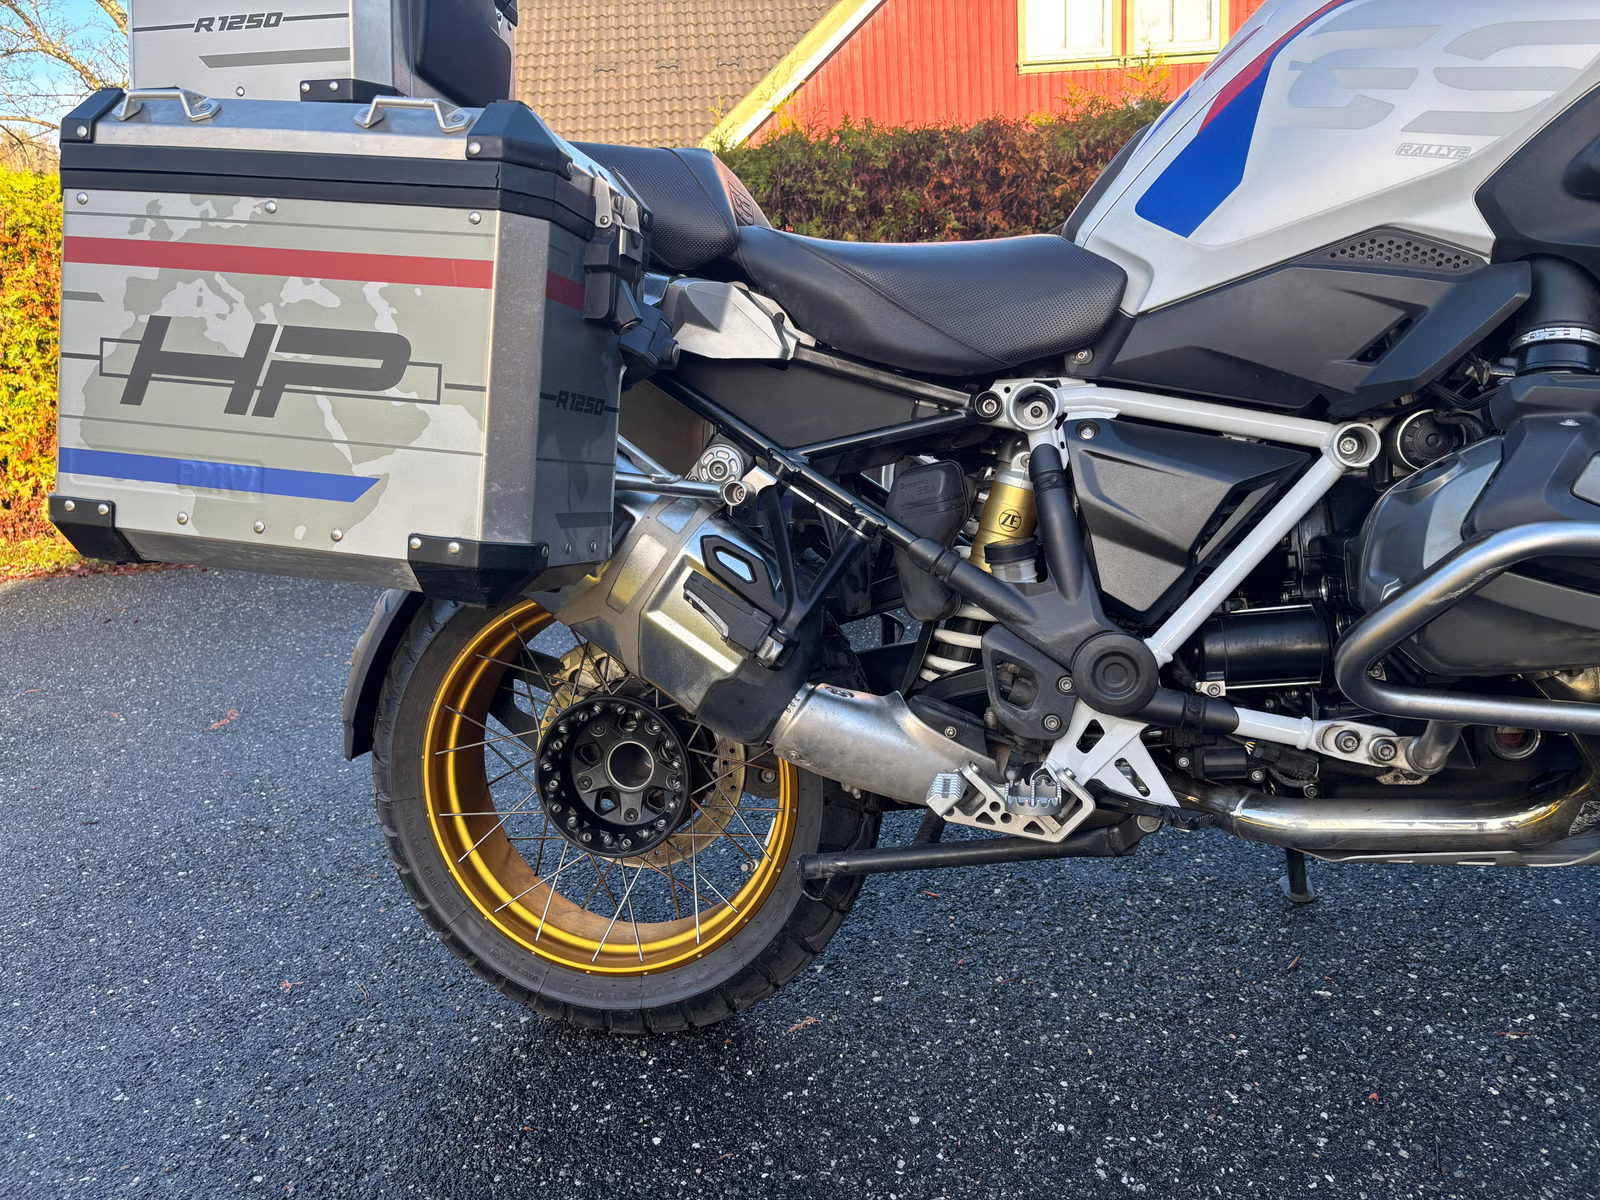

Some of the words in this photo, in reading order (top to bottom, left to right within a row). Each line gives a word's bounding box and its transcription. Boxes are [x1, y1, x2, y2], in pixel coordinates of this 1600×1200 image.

[194, 16, 215, 33] R
[218, 12, 283, 31] 1250
[1399, 144, 1471, 159] RALLYE
[119, 315, 412, 418] HP
[556, 390, 569, 410] R
[569, 392, 606, 416] 1250
[900, 479, 929, 490] Dynamic
[1000, 511, 1021, 530] ZF
